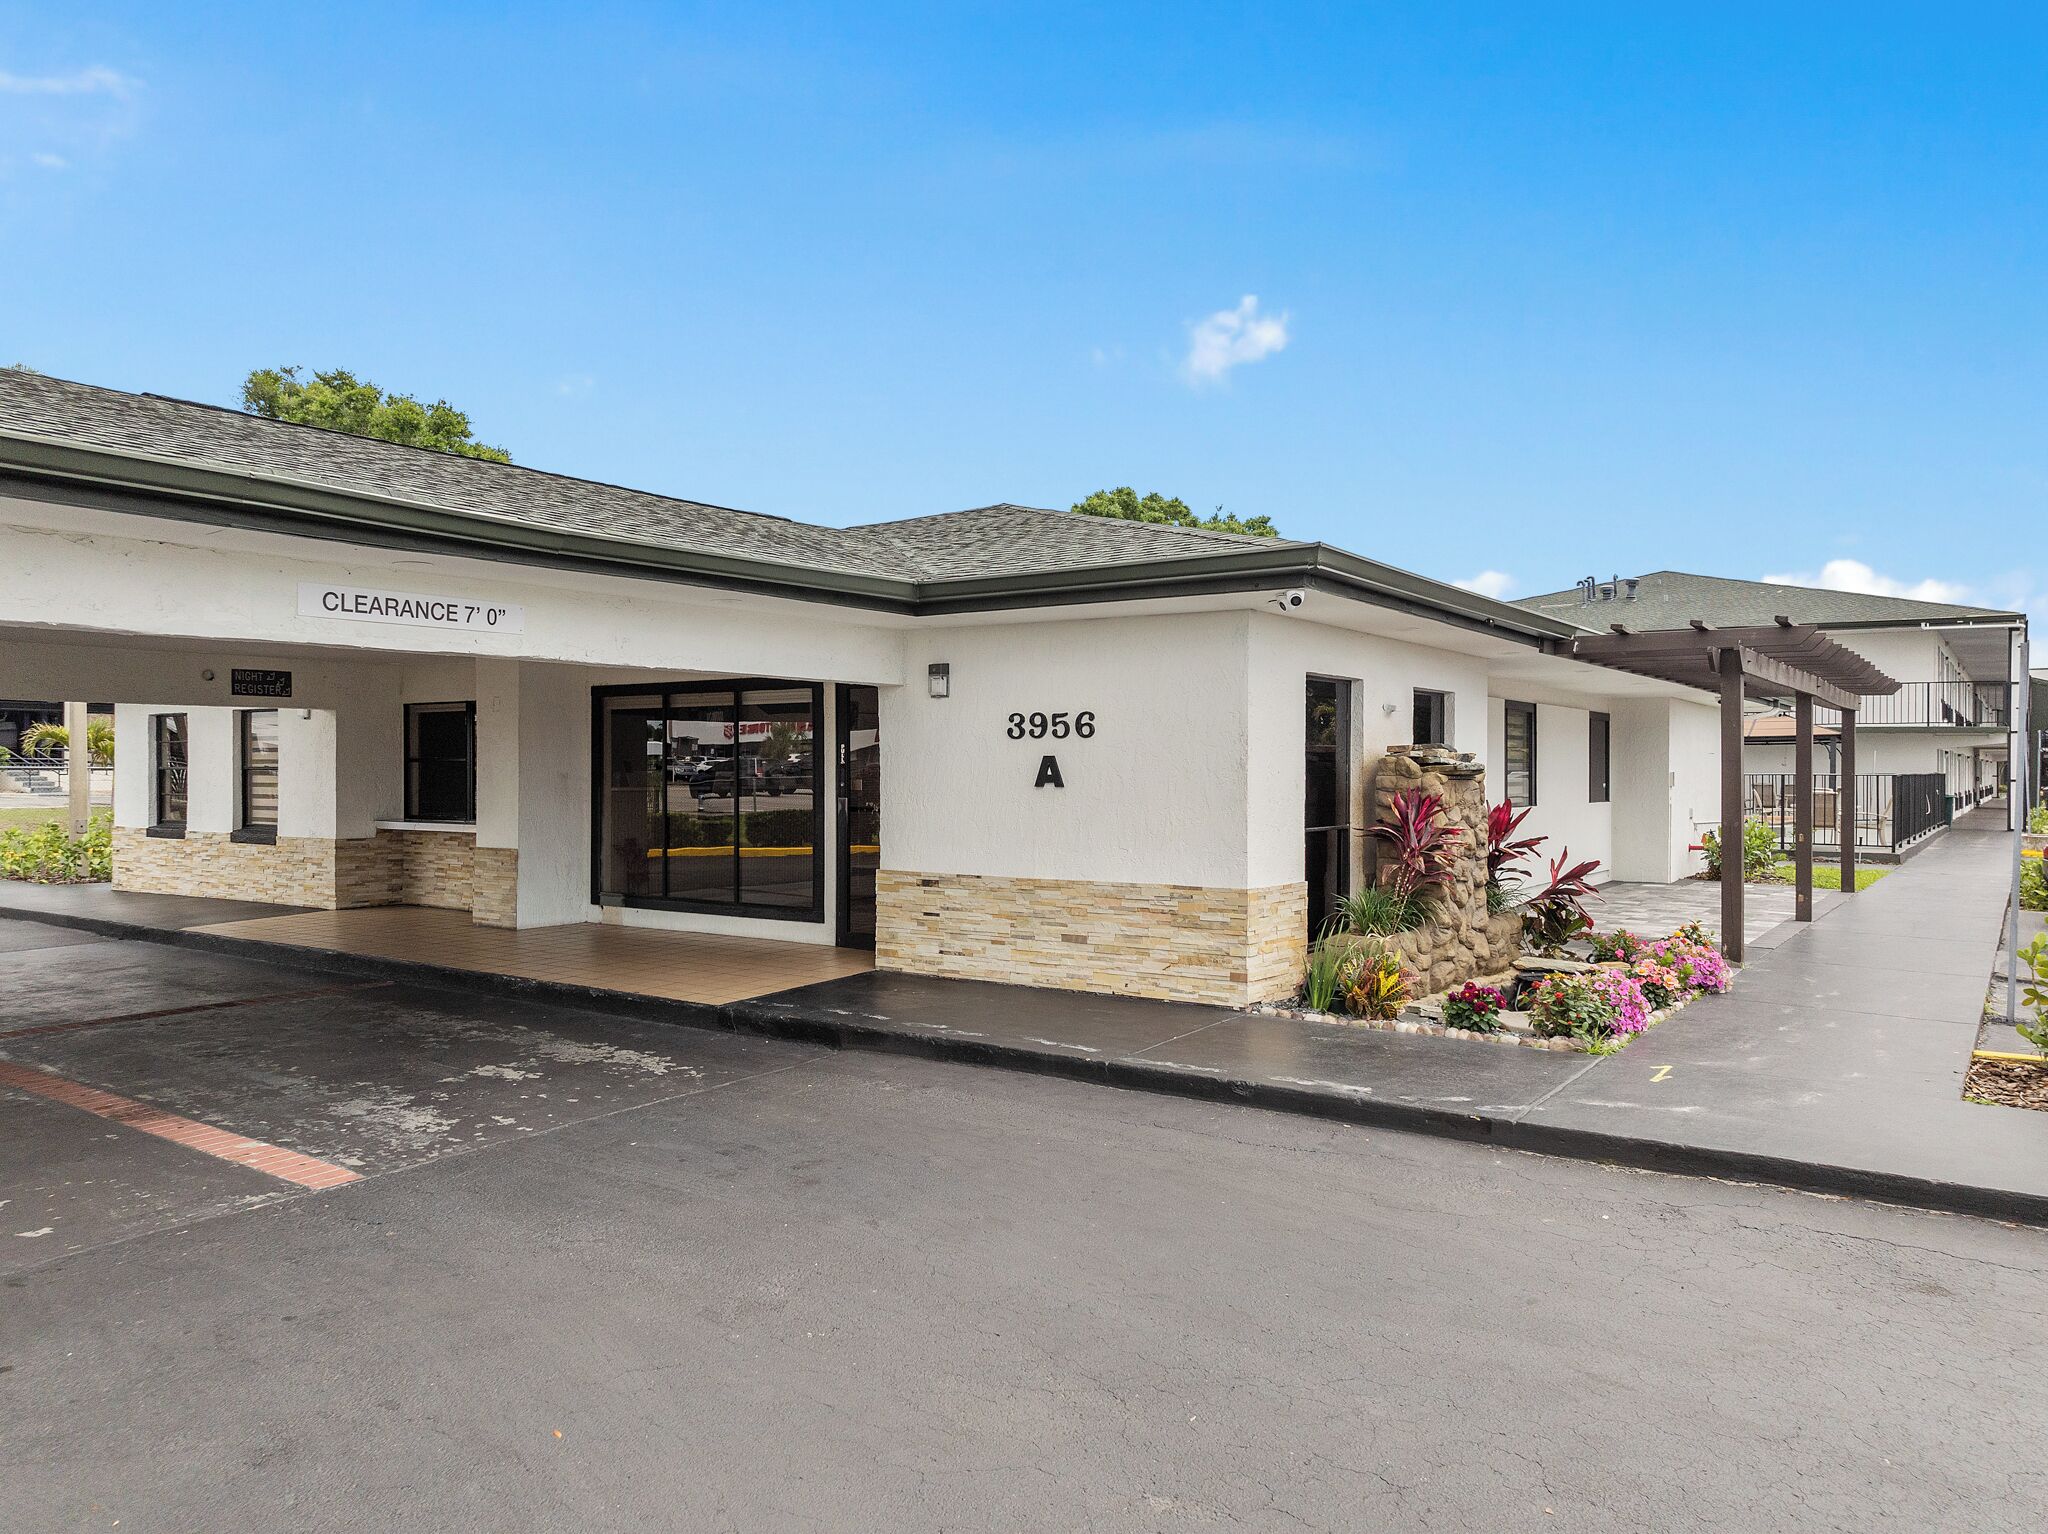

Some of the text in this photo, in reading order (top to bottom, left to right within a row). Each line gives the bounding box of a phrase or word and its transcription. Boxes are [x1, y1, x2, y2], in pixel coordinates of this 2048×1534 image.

[322, 591, 458, 622] CLEARANCE
[234, 683, 281, 695] REGISTER
[235, 671, 264, 681] NIGHT
[1007, 711, 1096, 740] 3956
[1034, 755, 1065, 788] A
